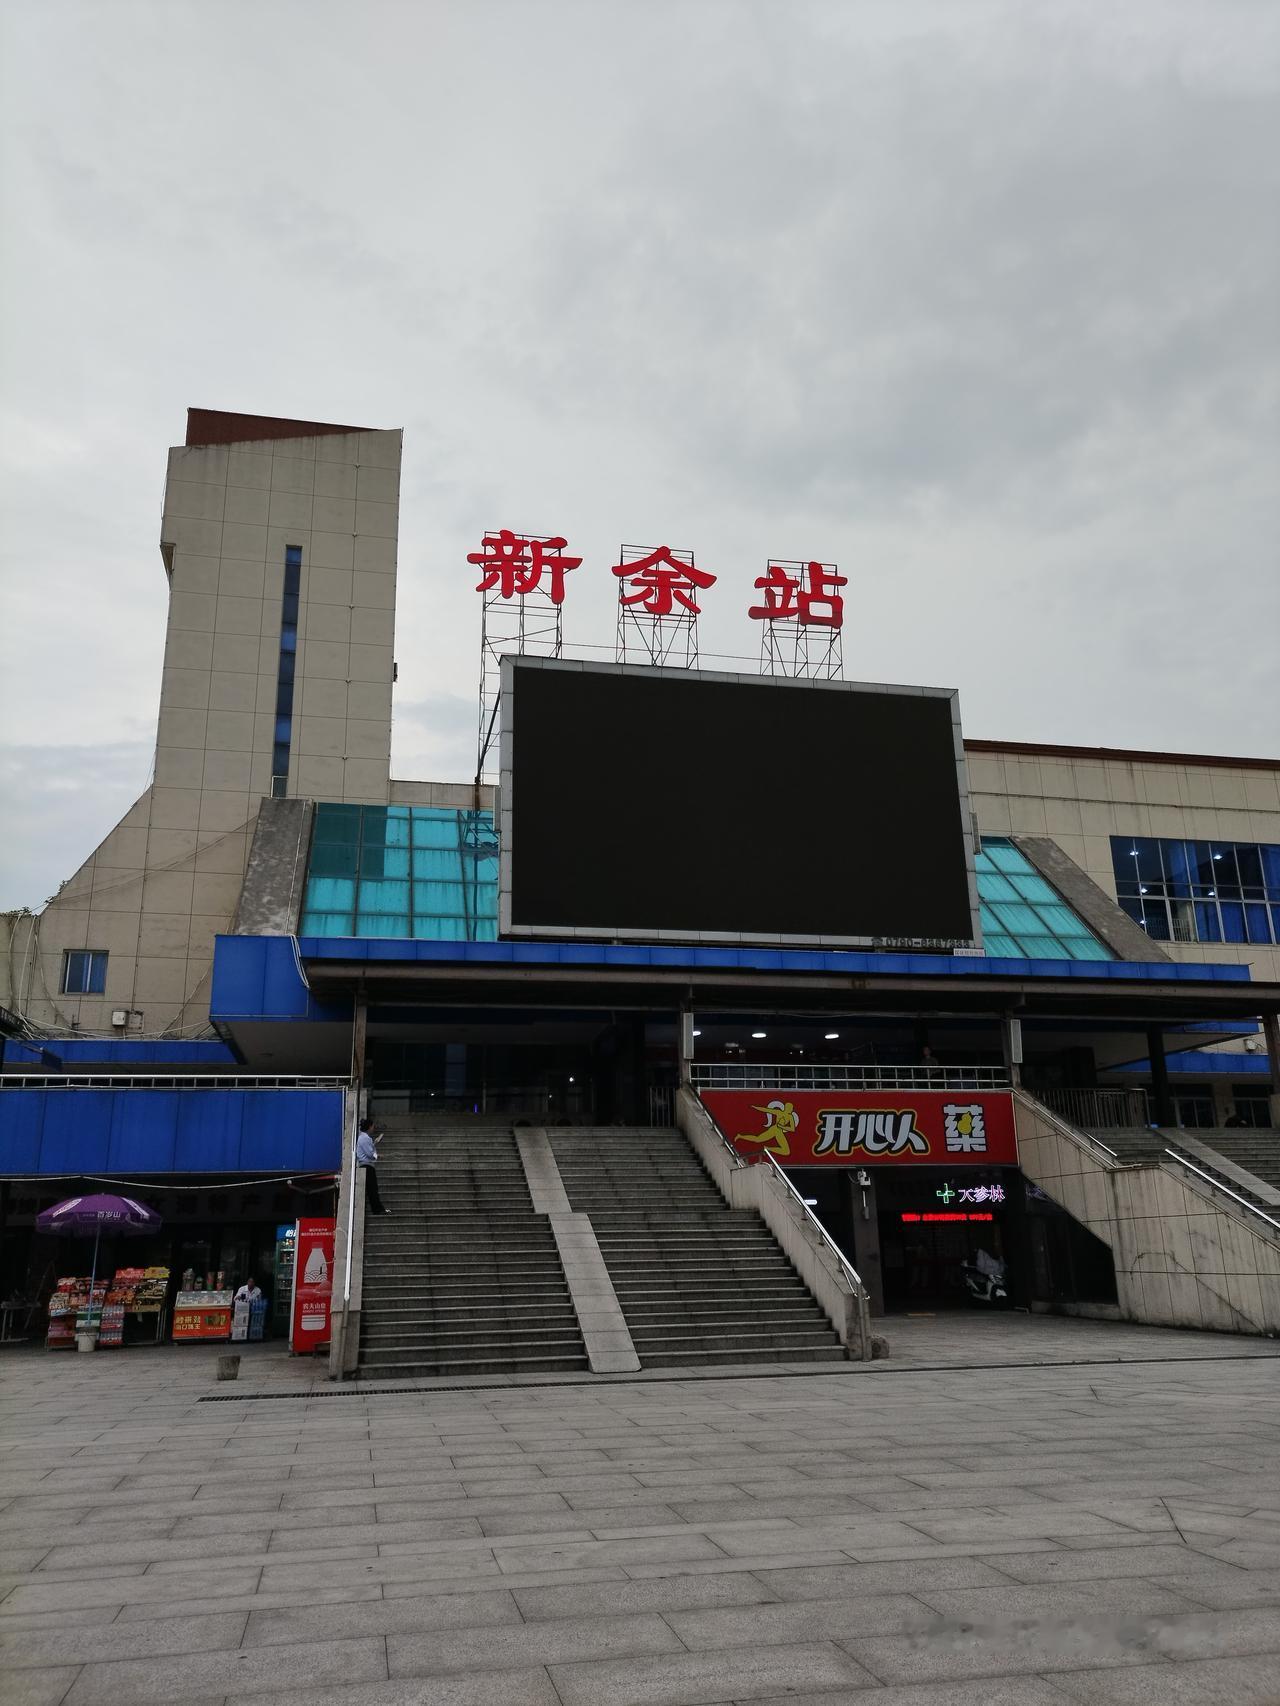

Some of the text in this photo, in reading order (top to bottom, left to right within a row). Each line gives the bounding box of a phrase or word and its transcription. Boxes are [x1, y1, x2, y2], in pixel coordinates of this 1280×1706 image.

[467, 529, 848, 630] 新余站
[815, 1112, 928, 1153] 开心人
